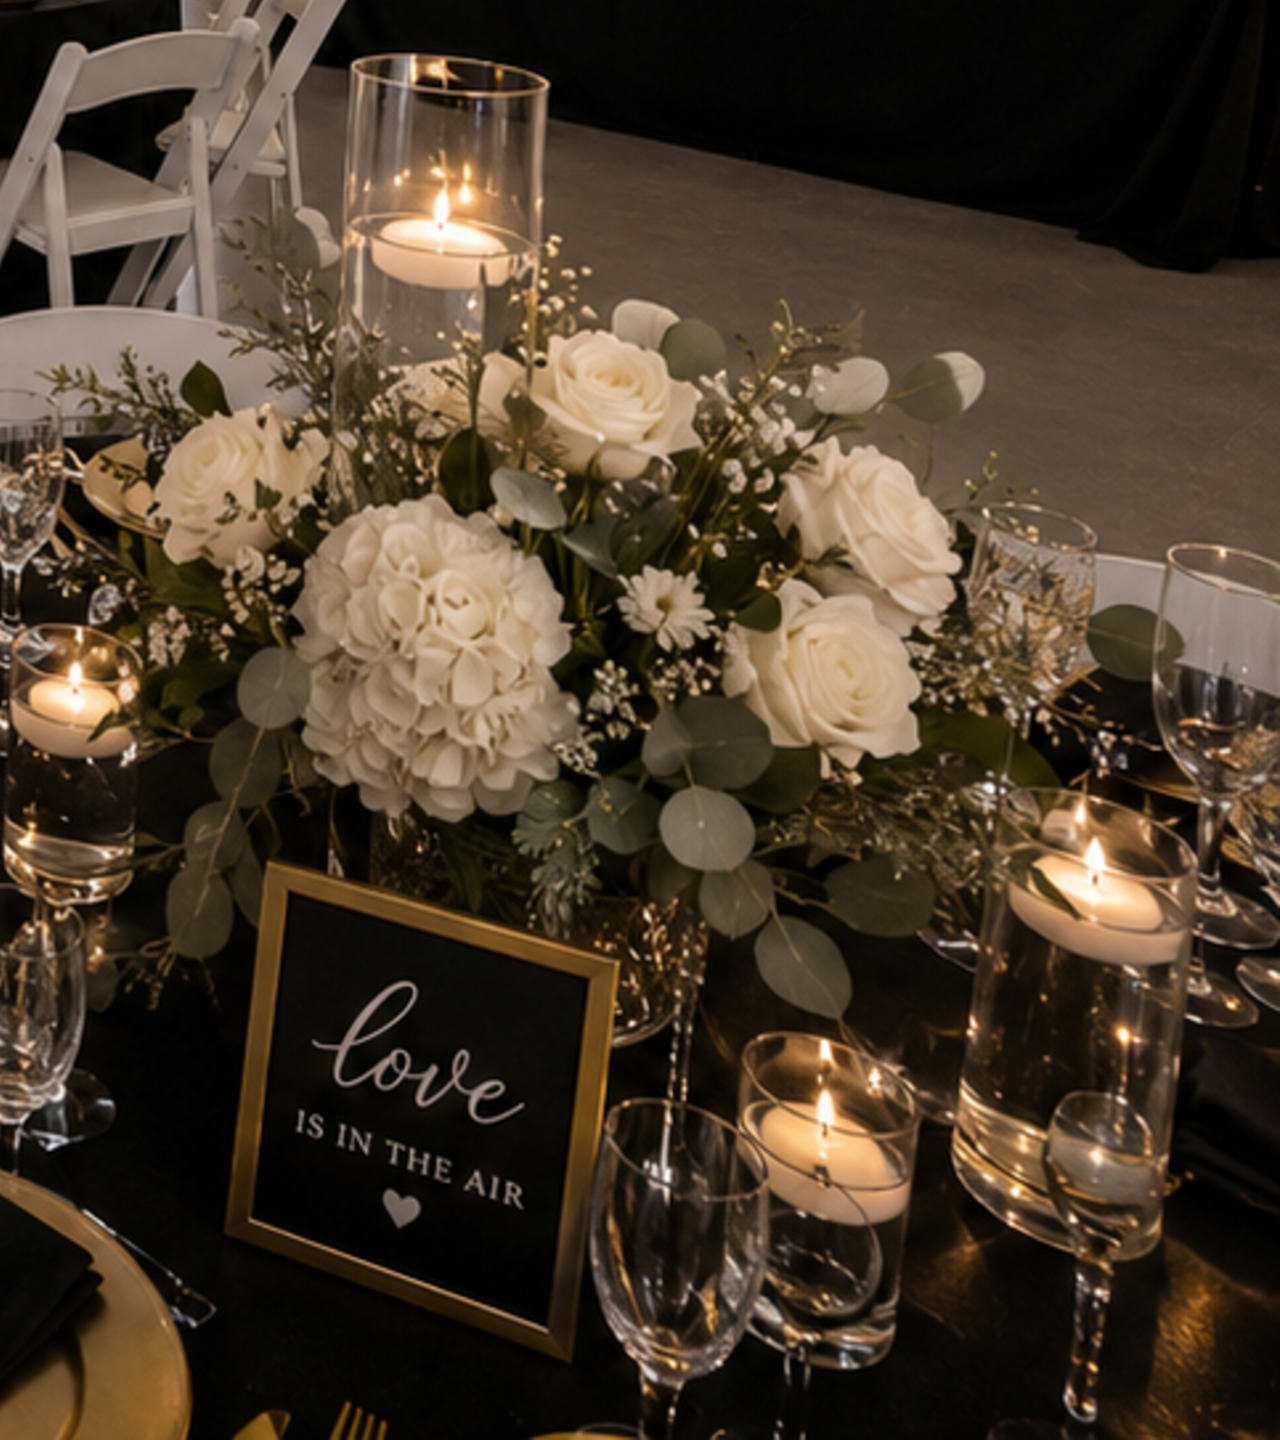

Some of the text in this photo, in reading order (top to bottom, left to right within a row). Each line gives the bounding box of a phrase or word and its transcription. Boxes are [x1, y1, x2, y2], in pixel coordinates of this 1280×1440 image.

[311, 980, 525, 1124] love
[295, 1109, 526, 1210] IS IN THE AIR
